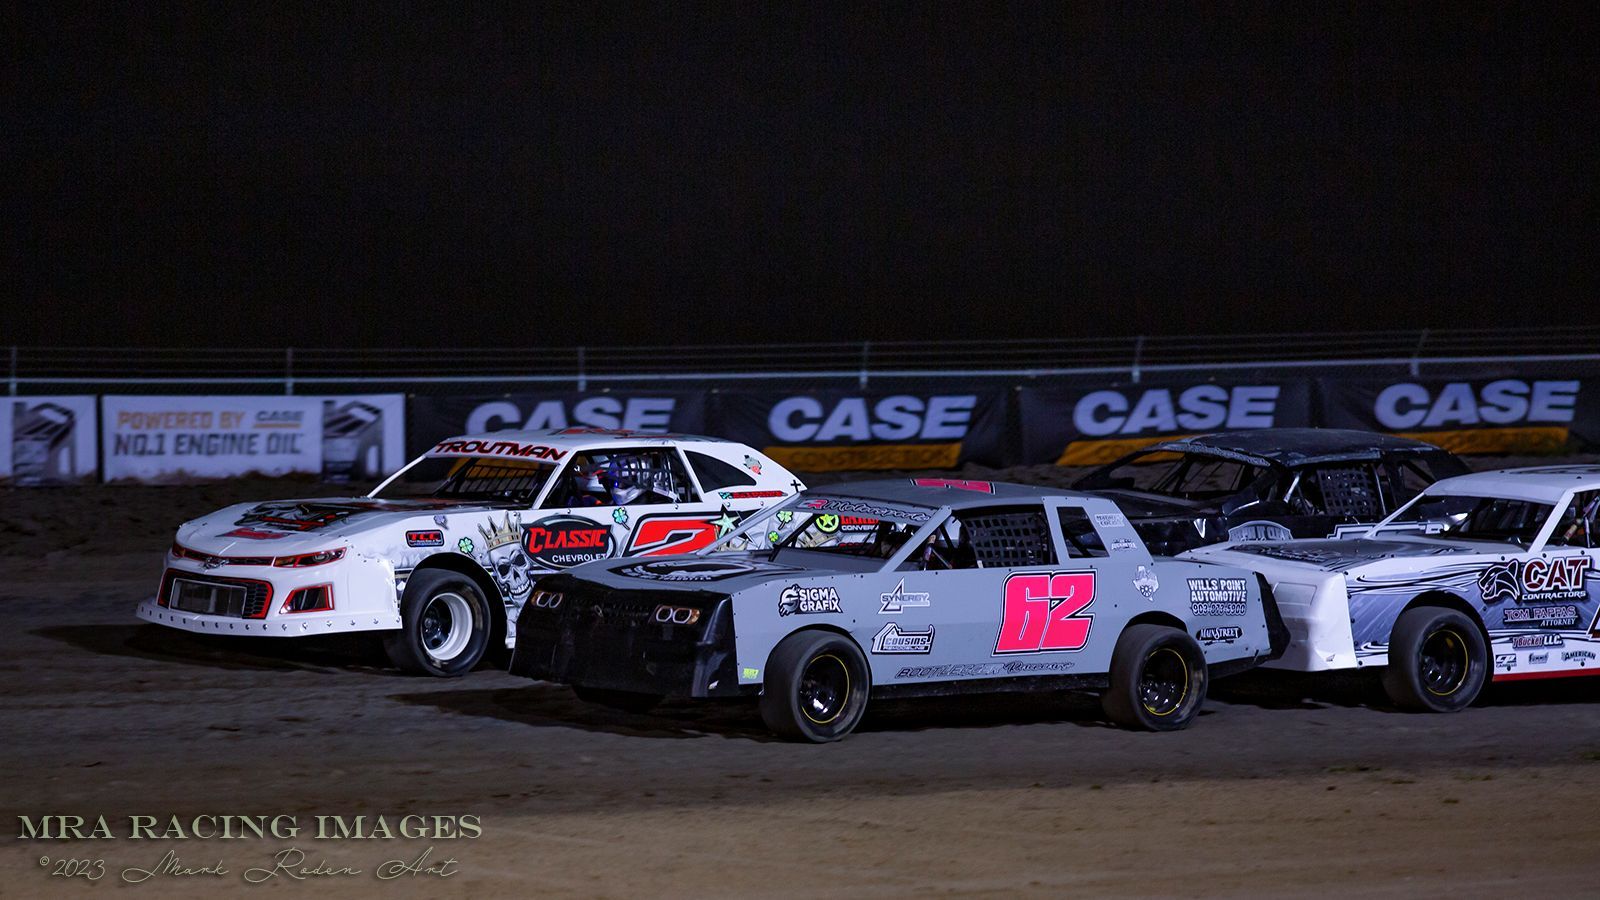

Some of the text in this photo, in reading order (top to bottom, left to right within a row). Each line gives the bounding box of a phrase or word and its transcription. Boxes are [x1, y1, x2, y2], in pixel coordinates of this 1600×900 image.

[1073, 385, 1281, 436] CASE
[1374, 379, 1581, 430] CASE
[117, 410, 304, 429] POWERED BY CASE
[465, 397, 676, 435] CASE
[768, 395, 977, 442] CASE
[114, 432, 304, 456] NO.1 ENGINE OIL
[434, 440, 569, 461] TROUTMAN
[552, 553, 607, 563] CHEVROLET
[1522, 556, 1591, 592] CAT
[1188, 579, 1246, 591] WILLS POINT
[799, 588, 838, 601] SIGMA
[882, 594, 929, 602] SYNERGY
[1191, 590, 1247, 602] AUTOMOTIVE
[1521, 591, 1586, 600] CONTRACTORS
[799, 600, 842, 613] GRAFIX
[991, 569, 1098, 657] 62
[1504, 606, 1576, 620] TOM PAPPAS
[1540, 618, 1576, 627] ATTORNEY
[1543, 635, 1562, 645] LLC.
[1564, 650, 1596, 661] AMERICAN
